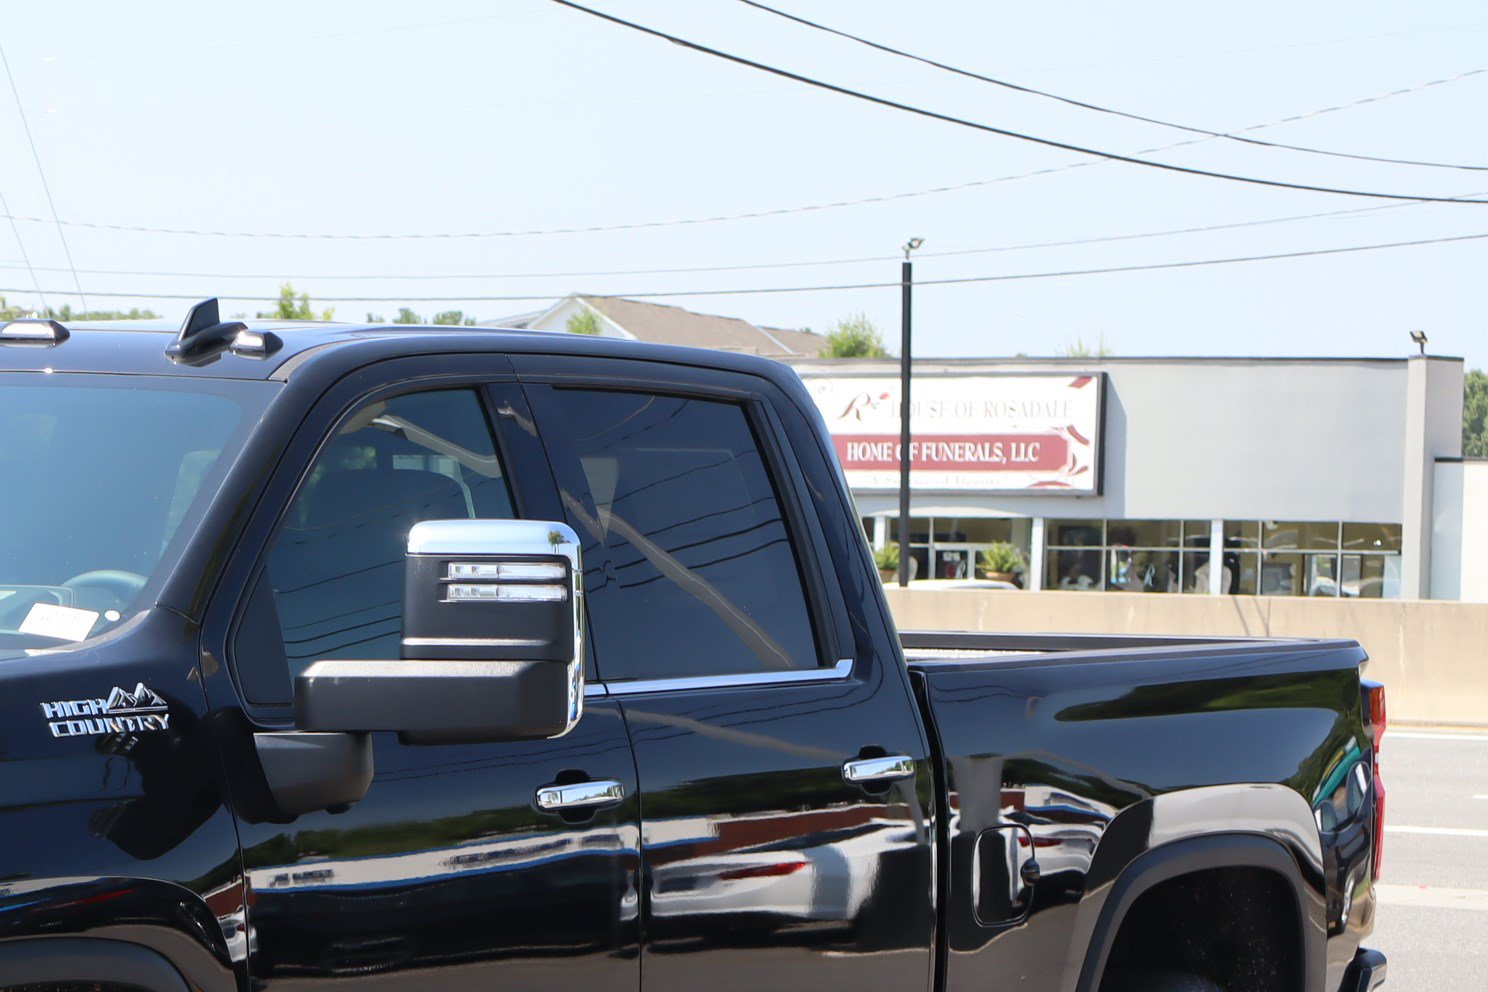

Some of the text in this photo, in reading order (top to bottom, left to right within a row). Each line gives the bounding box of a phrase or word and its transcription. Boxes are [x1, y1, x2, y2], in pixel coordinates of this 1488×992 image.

[954, 400, 977, 419] OF
[984, 400, 1074, 419] ROSADALE
[847, 441, 892, 462] HOME
[922, 442, 1007, 465] FUNERALS,
[1011, 442, 1041, 463] LLC
[41, 698, 109, 718] HIGH
[49, 714, 170, 738] COUNTRY
